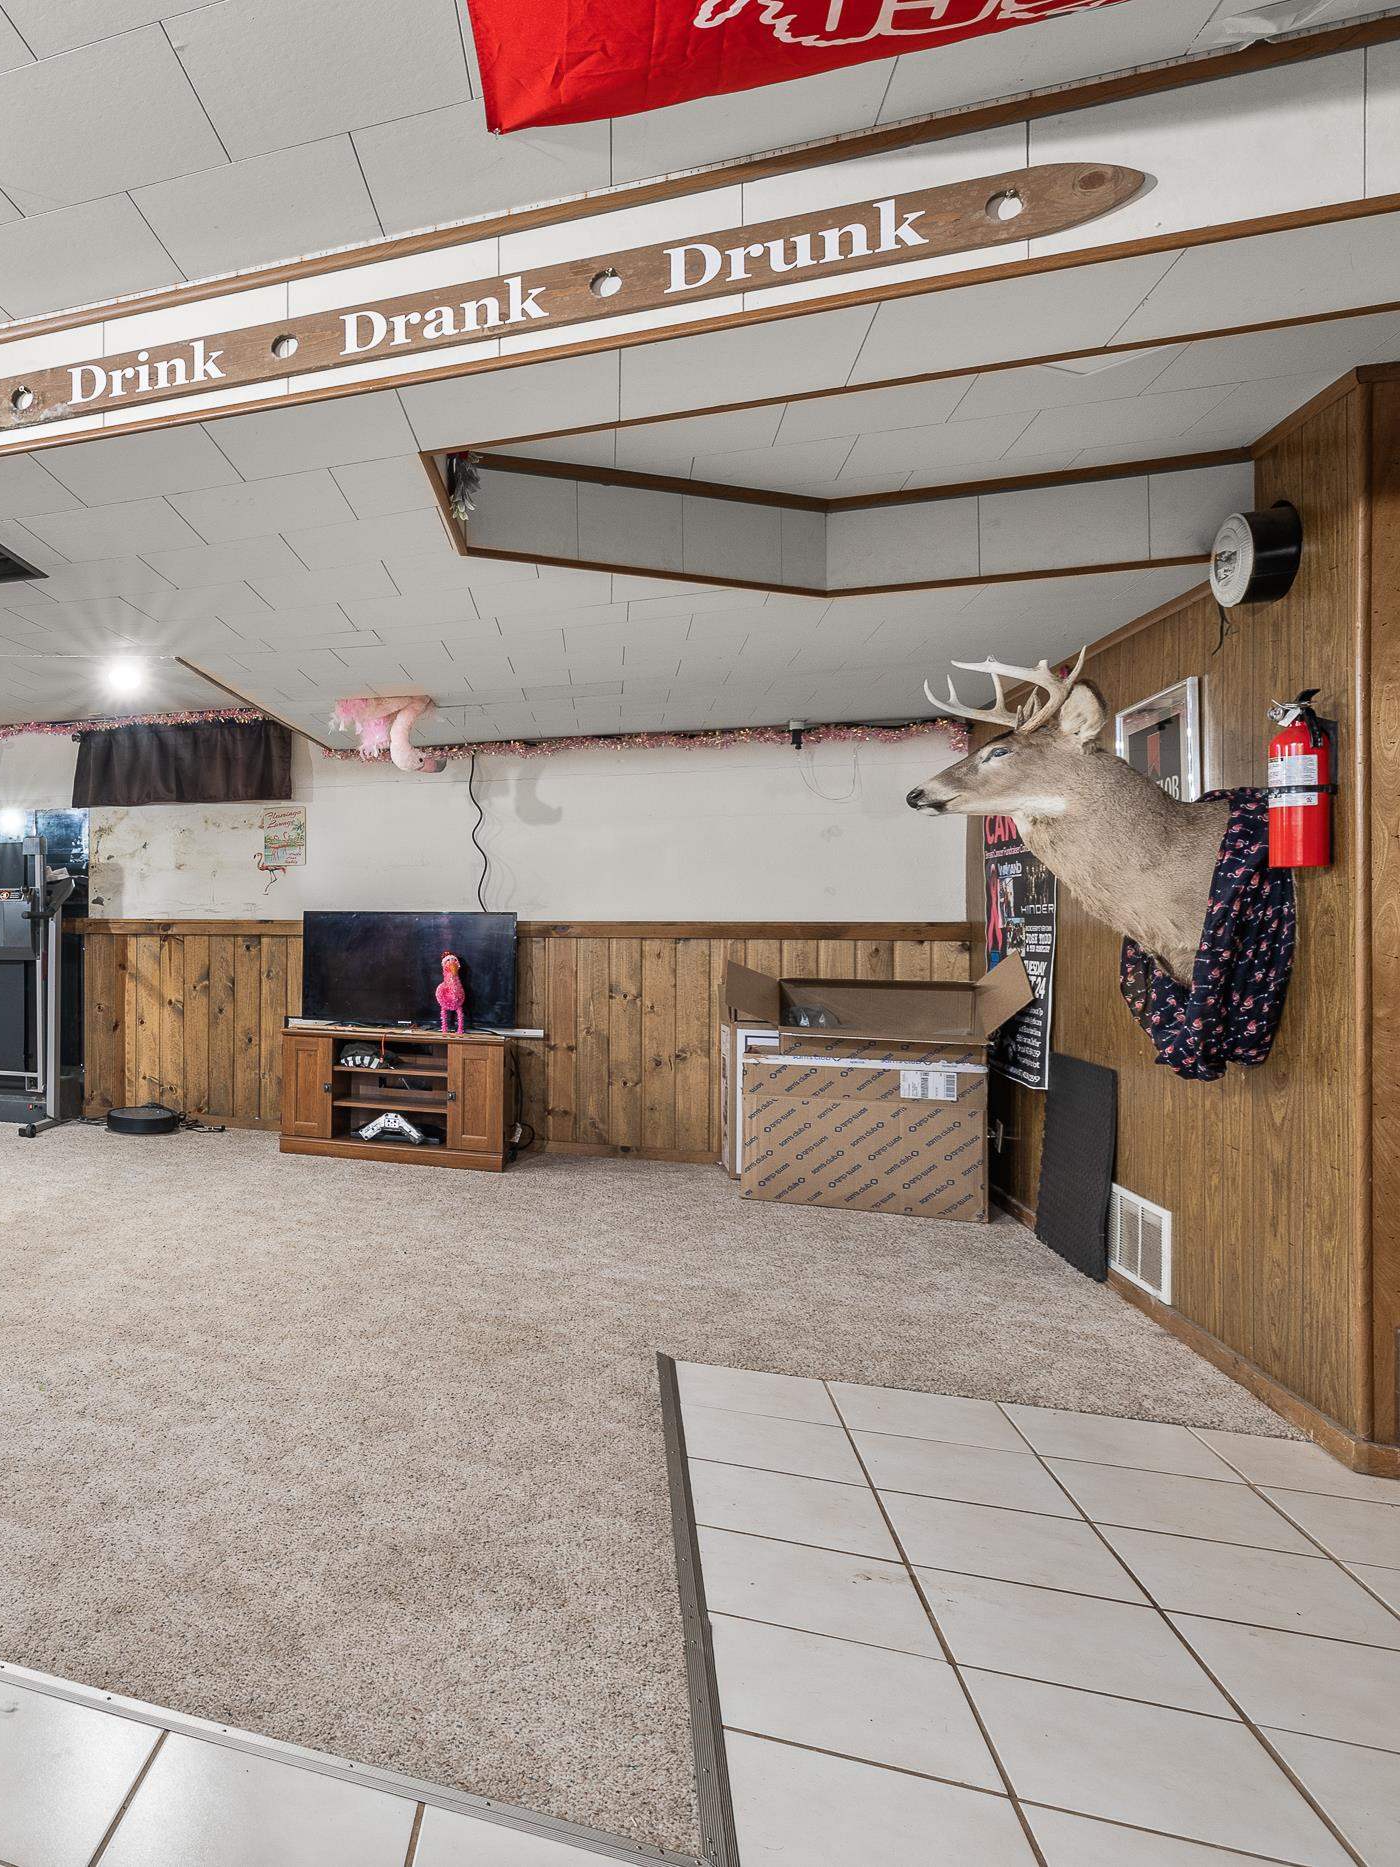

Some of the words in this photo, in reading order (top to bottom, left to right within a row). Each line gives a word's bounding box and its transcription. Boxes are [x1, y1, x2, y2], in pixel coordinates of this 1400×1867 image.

[67, 340, 226, 405] Drink
[339, 276, 549, 355] Drank
[664, 199, 929, 293] Drunk
[1021, 904, 1054, 914] HINDER
